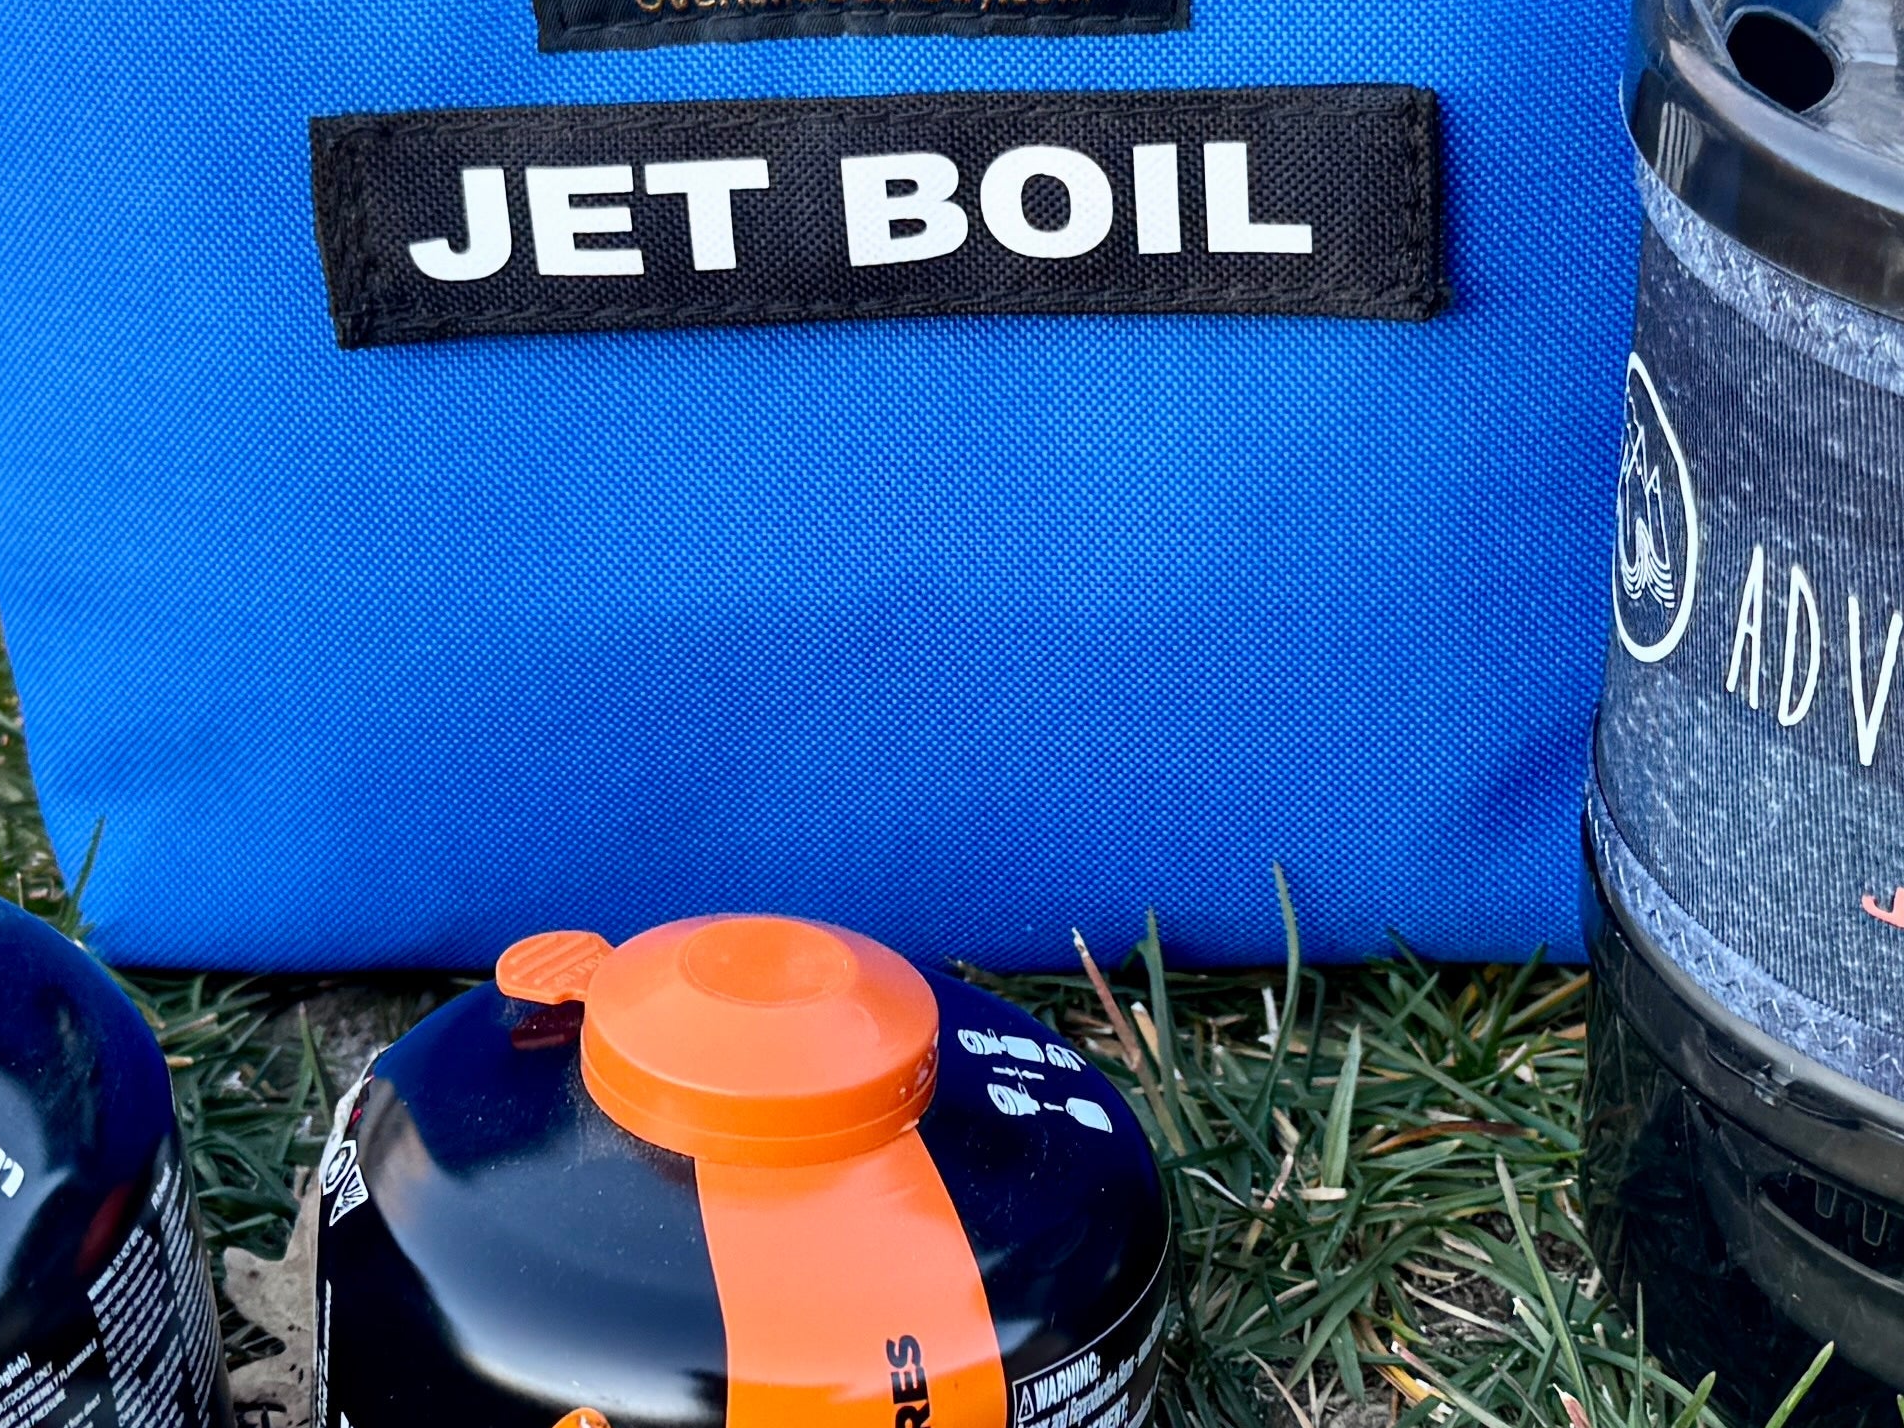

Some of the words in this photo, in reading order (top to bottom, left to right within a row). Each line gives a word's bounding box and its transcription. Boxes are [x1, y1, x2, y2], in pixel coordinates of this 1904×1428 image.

[407, 158, 771, 283] JET
[839, 140, 1314, 269] BOIL
[1034, 1351, 1101, 1412] WARNING:
